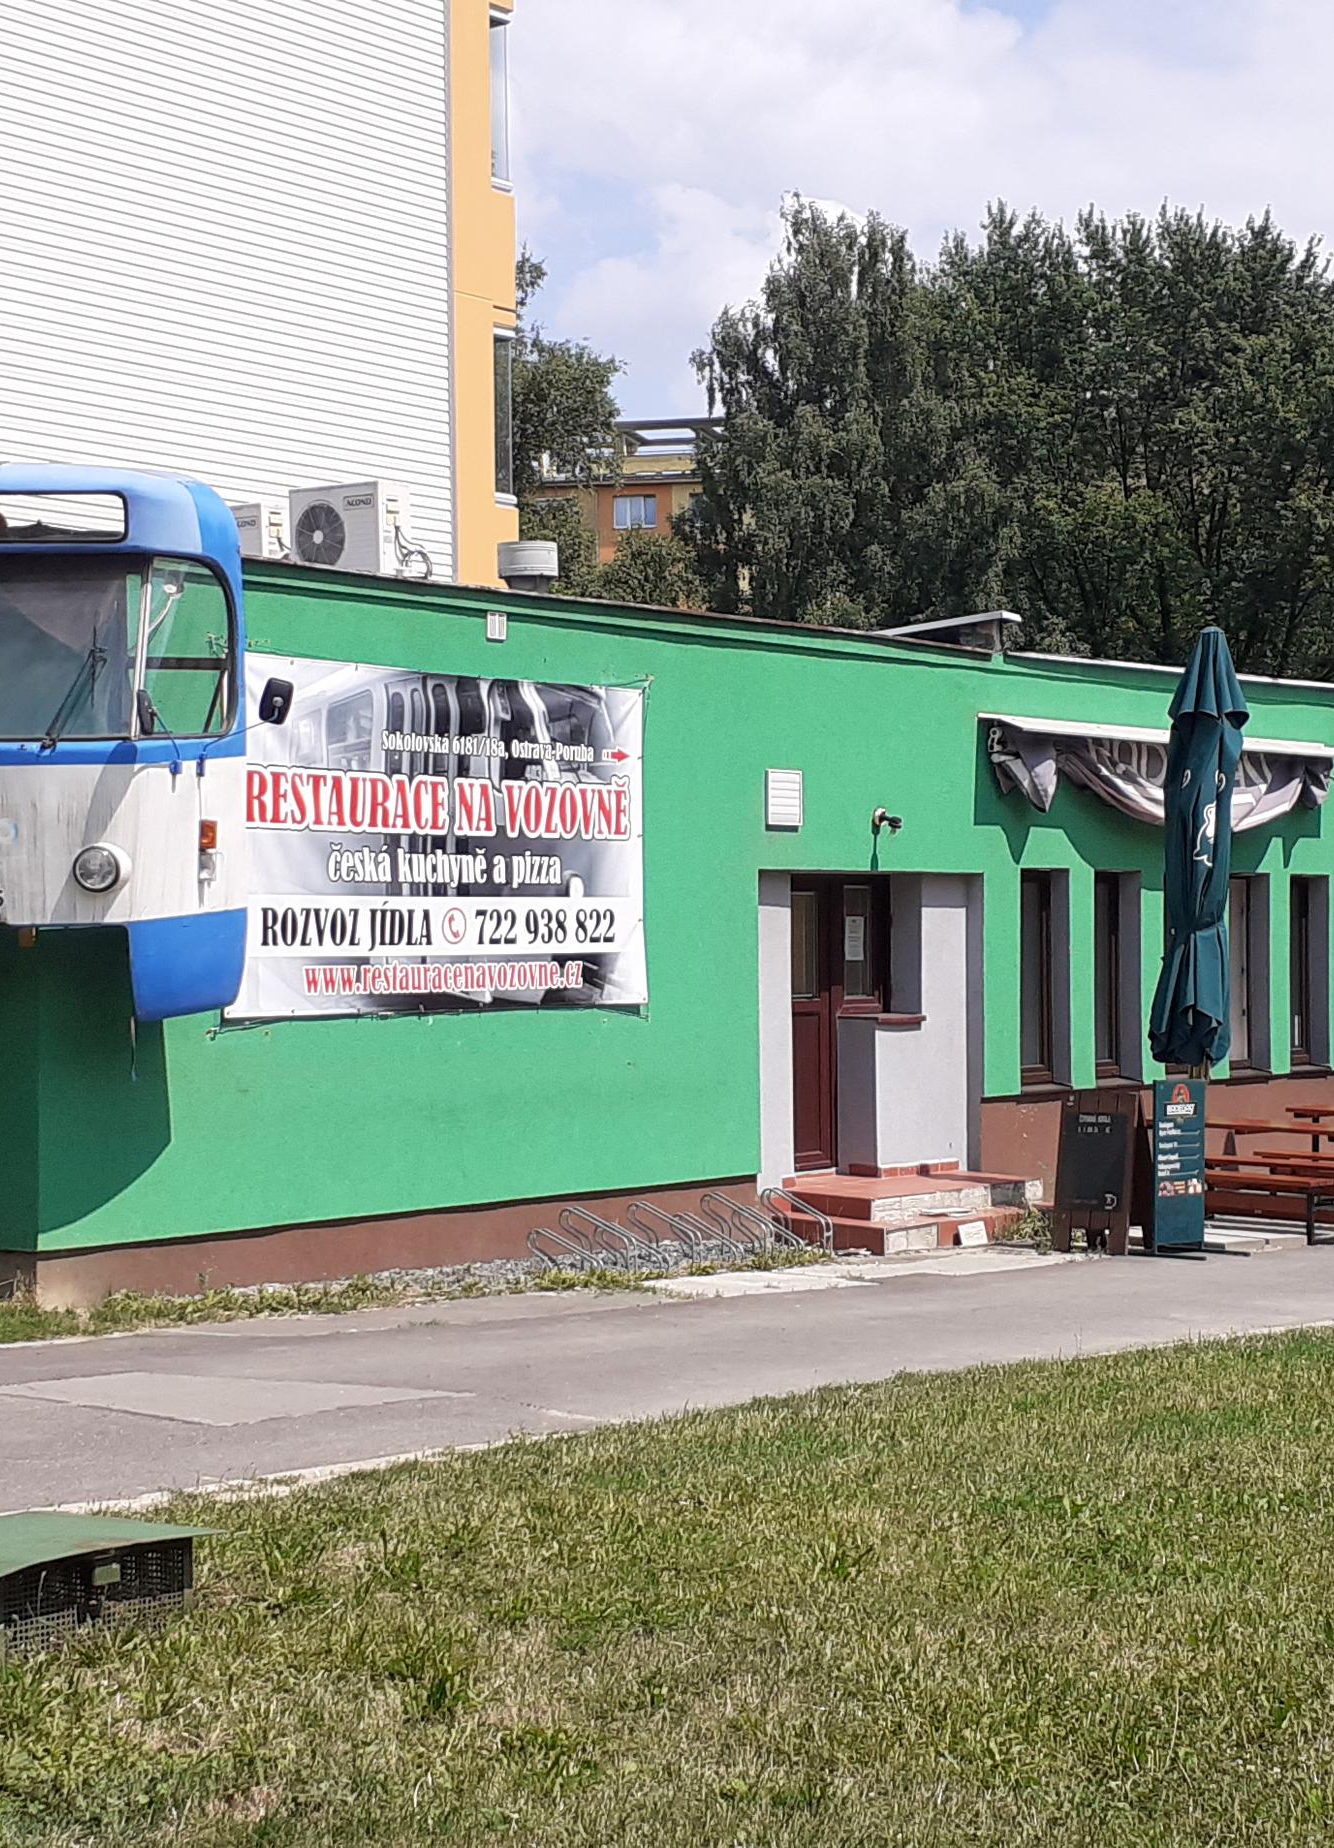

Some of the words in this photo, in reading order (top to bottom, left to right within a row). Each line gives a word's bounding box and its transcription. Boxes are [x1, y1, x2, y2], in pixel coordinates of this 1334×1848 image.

[381, 729, 450, 754] Sokolovská
[452, 736, 509, 760] 6181/18a,
[511, 739, 595, 762] Ostrava-Poruba
[246, 769, 447, 831] RESTAURACE
[457, 781, 495, 832] NA
[504, 777, 630, 836] VOZOVNĚ
[328, 843, 392, 884] česká
[398, 846, 488, 889] kuchyně
[493, 856, 505, 884] a
[512, 852, 562, 889] pizza
[260, 906, 361, 947] ROZVOZ
[368, 901, 433, 952] JÍDLA
[475, 908, 518, 945] 722
[525, 908, 568, 945] 938
[575, 908, 616, 944] 822
[304, 960, 584, 995] www.restauracenavozovne.cz
